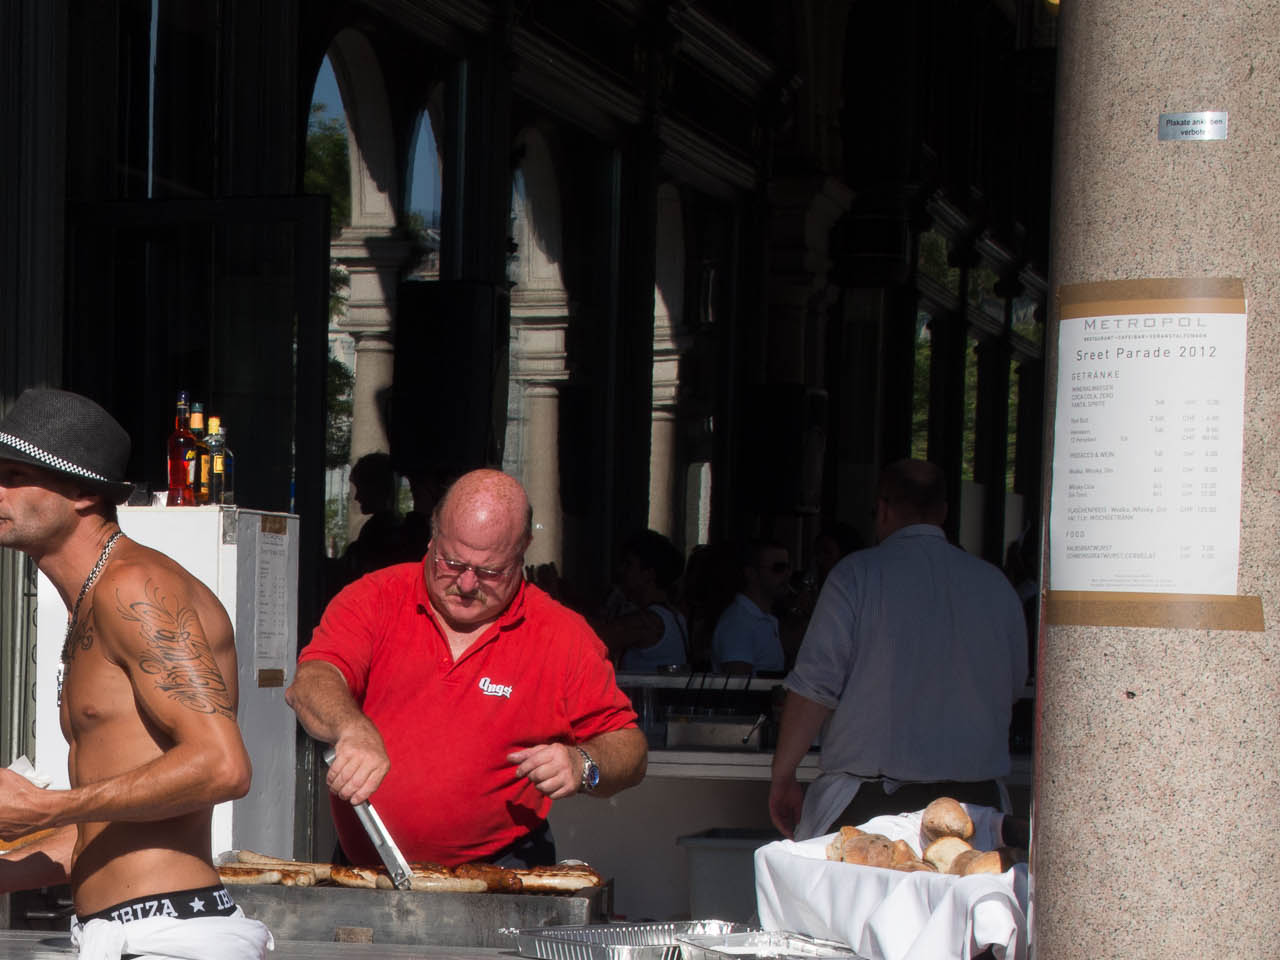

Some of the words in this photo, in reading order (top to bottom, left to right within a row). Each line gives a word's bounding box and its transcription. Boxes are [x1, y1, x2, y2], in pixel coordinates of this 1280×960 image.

[1083, 317, 1207, 331] METROPOL
[1076, 349, 1110, 362] Sreet
[1116, 346, 1172, 360] Parade
[1179, 345, 1217, 358] 2012
[111, 898, 178, 925] IBIZA
